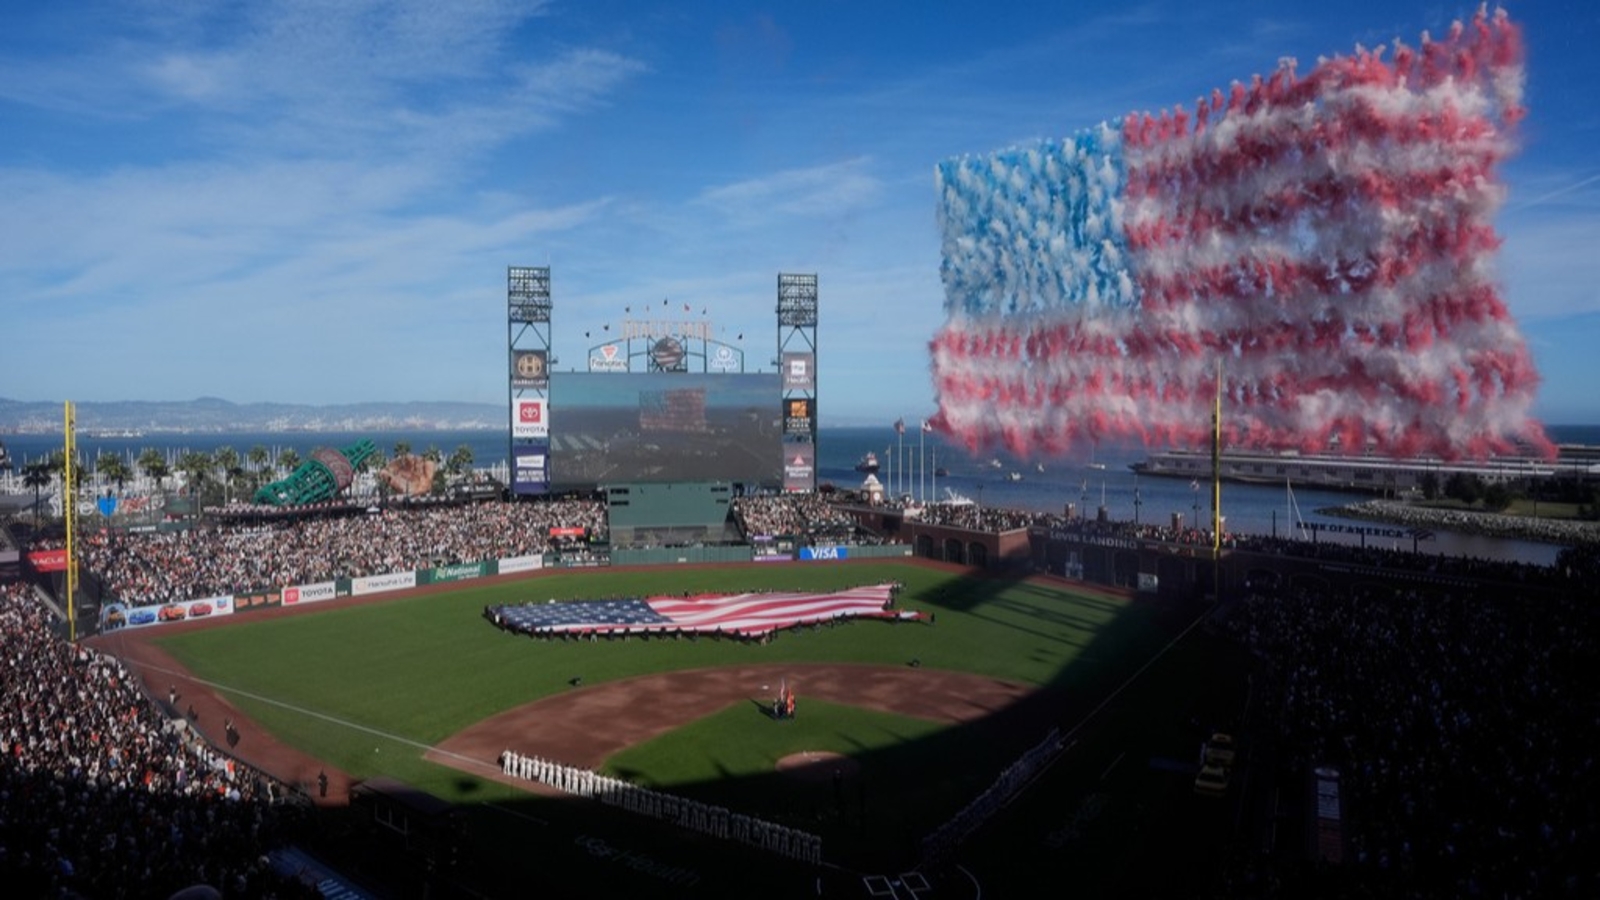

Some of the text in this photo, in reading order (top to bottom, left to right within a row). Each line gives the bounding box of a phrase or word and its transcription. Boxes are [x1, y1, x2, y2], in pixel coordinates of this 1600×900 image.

[1329, 524, 1343, 533] OF
[1346, 525, 1402, 538] AMERICA
[1082, 534, 1137, 550] LANDING
[807, 546, 838, 559] VISA
[302, 587, 333, 597] TOYOTA
